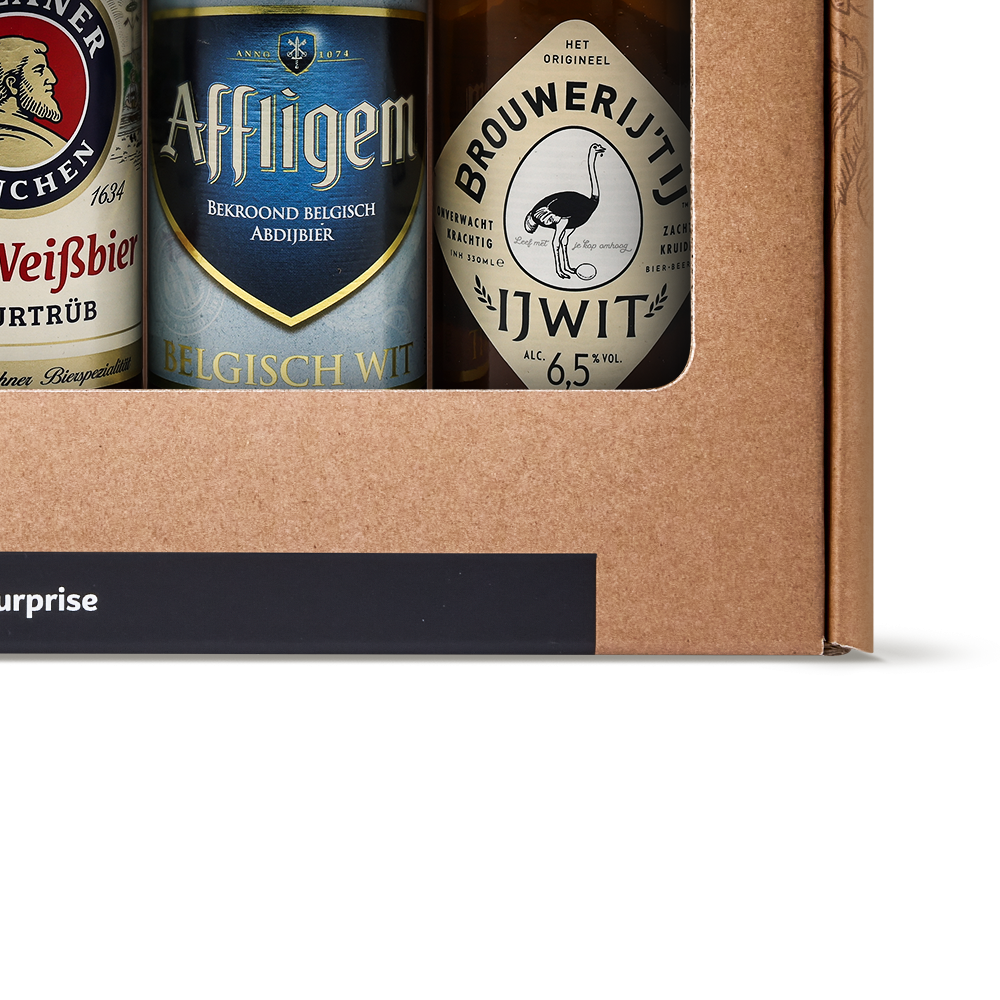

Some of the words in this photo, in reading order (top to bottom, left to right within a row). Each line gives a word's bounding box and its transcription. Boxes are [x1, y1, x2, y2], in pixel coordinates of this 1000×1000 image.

[236, 50, 271, 59] ANNO
[318, 50, 350, 59] 1074
[565, 40, 590, 50] HET
[543, 53, 611, 66] ORIGINEEL
[160, 80, 418, 192] Affligem
[90, 180, 126, 208] 1634
[207, 199, 300, 222] BEKROOND
[303, 201, 377, 222] BELGISCH
[436, 205, 494, 231] ONVERWACHT
[446, 227, 493, 250] KRACHTIG
[450, 249, 464, 259] INH
[498, 288, 649, 342] IJWIT
[39, 356, 133, 387] Bierspezialität
[163, 338, 344, 387] BELGISCH
[354, 341, 415, 383] WIT
[523, 350, 546, 361] ALC.
[547, 352, 590, 390] 6,5
